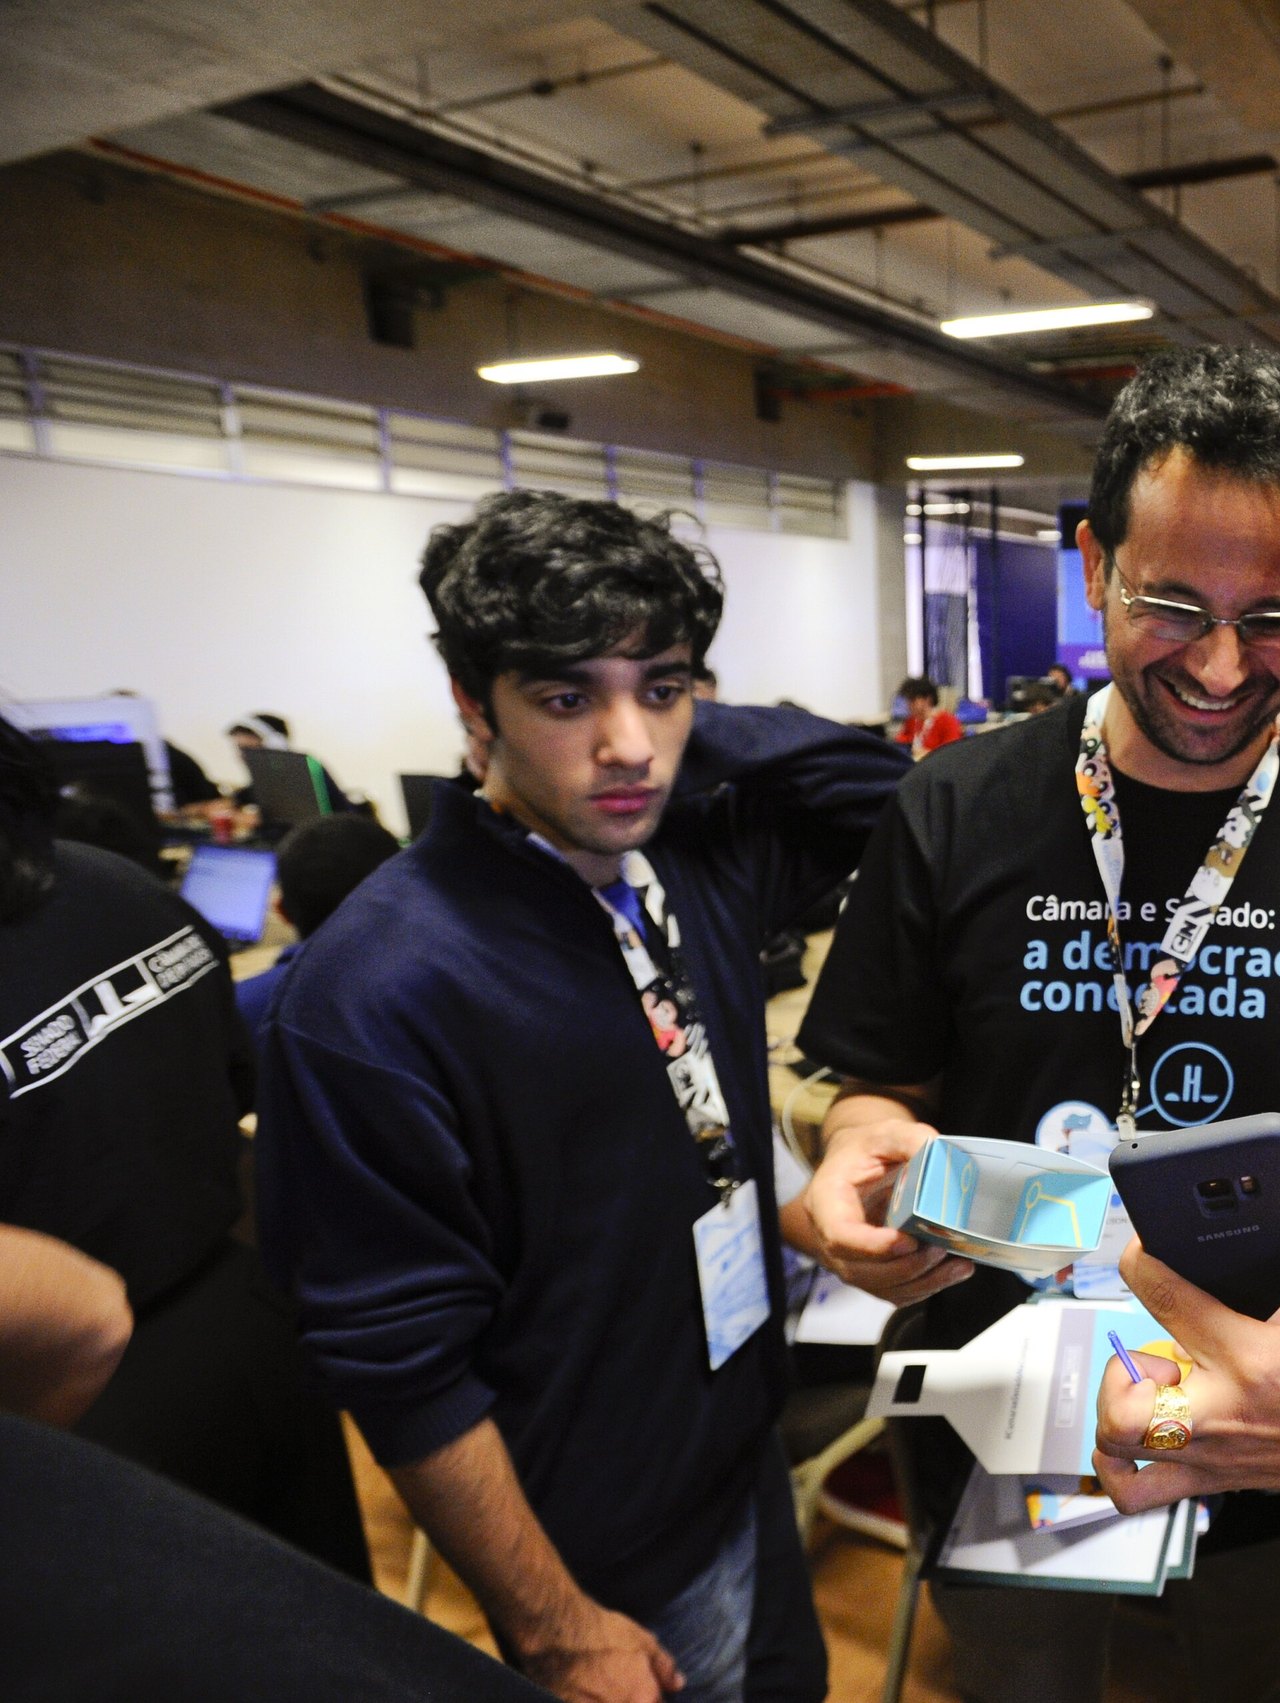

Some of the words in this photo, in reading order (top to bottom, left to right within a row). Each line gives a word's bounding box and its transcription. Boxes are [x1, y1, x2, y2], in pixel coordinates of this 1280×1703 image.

[1140, 902, 1157, 922] e
[1165, 898, 1276, 931] Sado:
[1023, 940, 1048, 971] a
[1197, 1224, 1260, 1243] SAMSUNG
